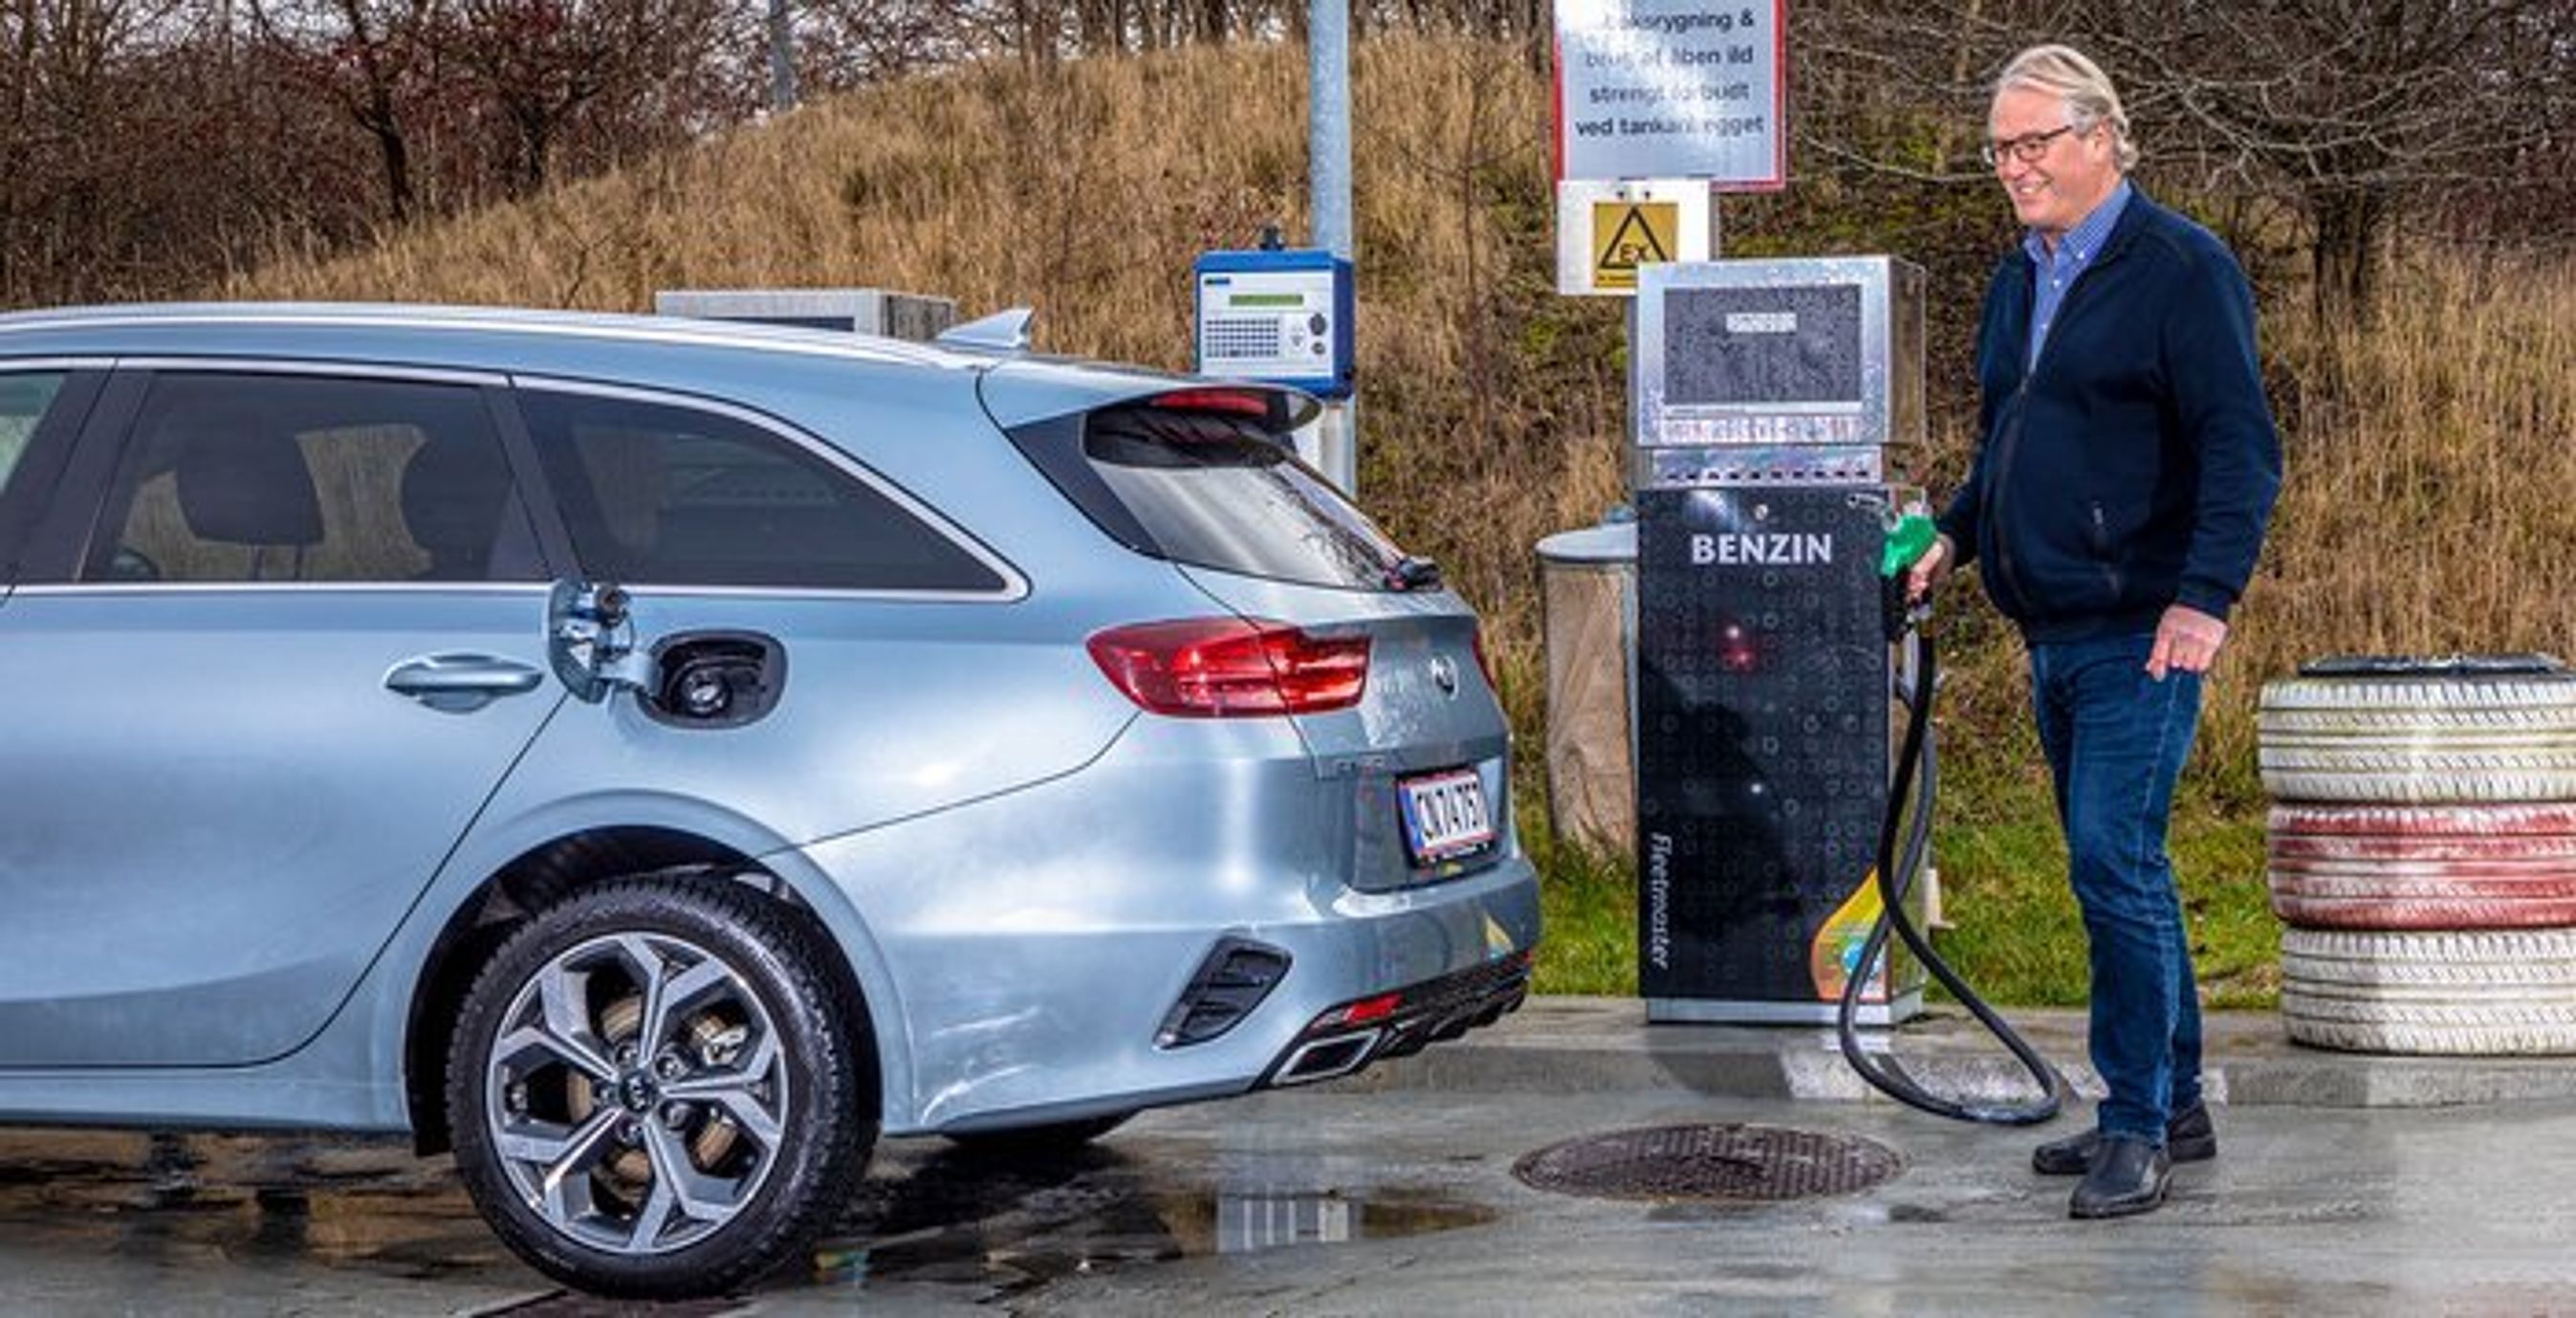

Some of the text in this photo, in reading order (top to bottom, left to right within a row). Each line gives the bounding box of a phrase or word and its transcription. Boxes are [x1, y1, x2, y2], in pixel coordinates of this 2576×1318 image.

[1739, 8, 1755, 27] &
[1728, 45, 1754, 64] ild
[1575, 118, 1613, 137] ved
[1620, 243, 1649, 263] EX
[1692, 533, 1832, 564] BENZIN
[1649, 831, 1672, 970] Fleetmaster
